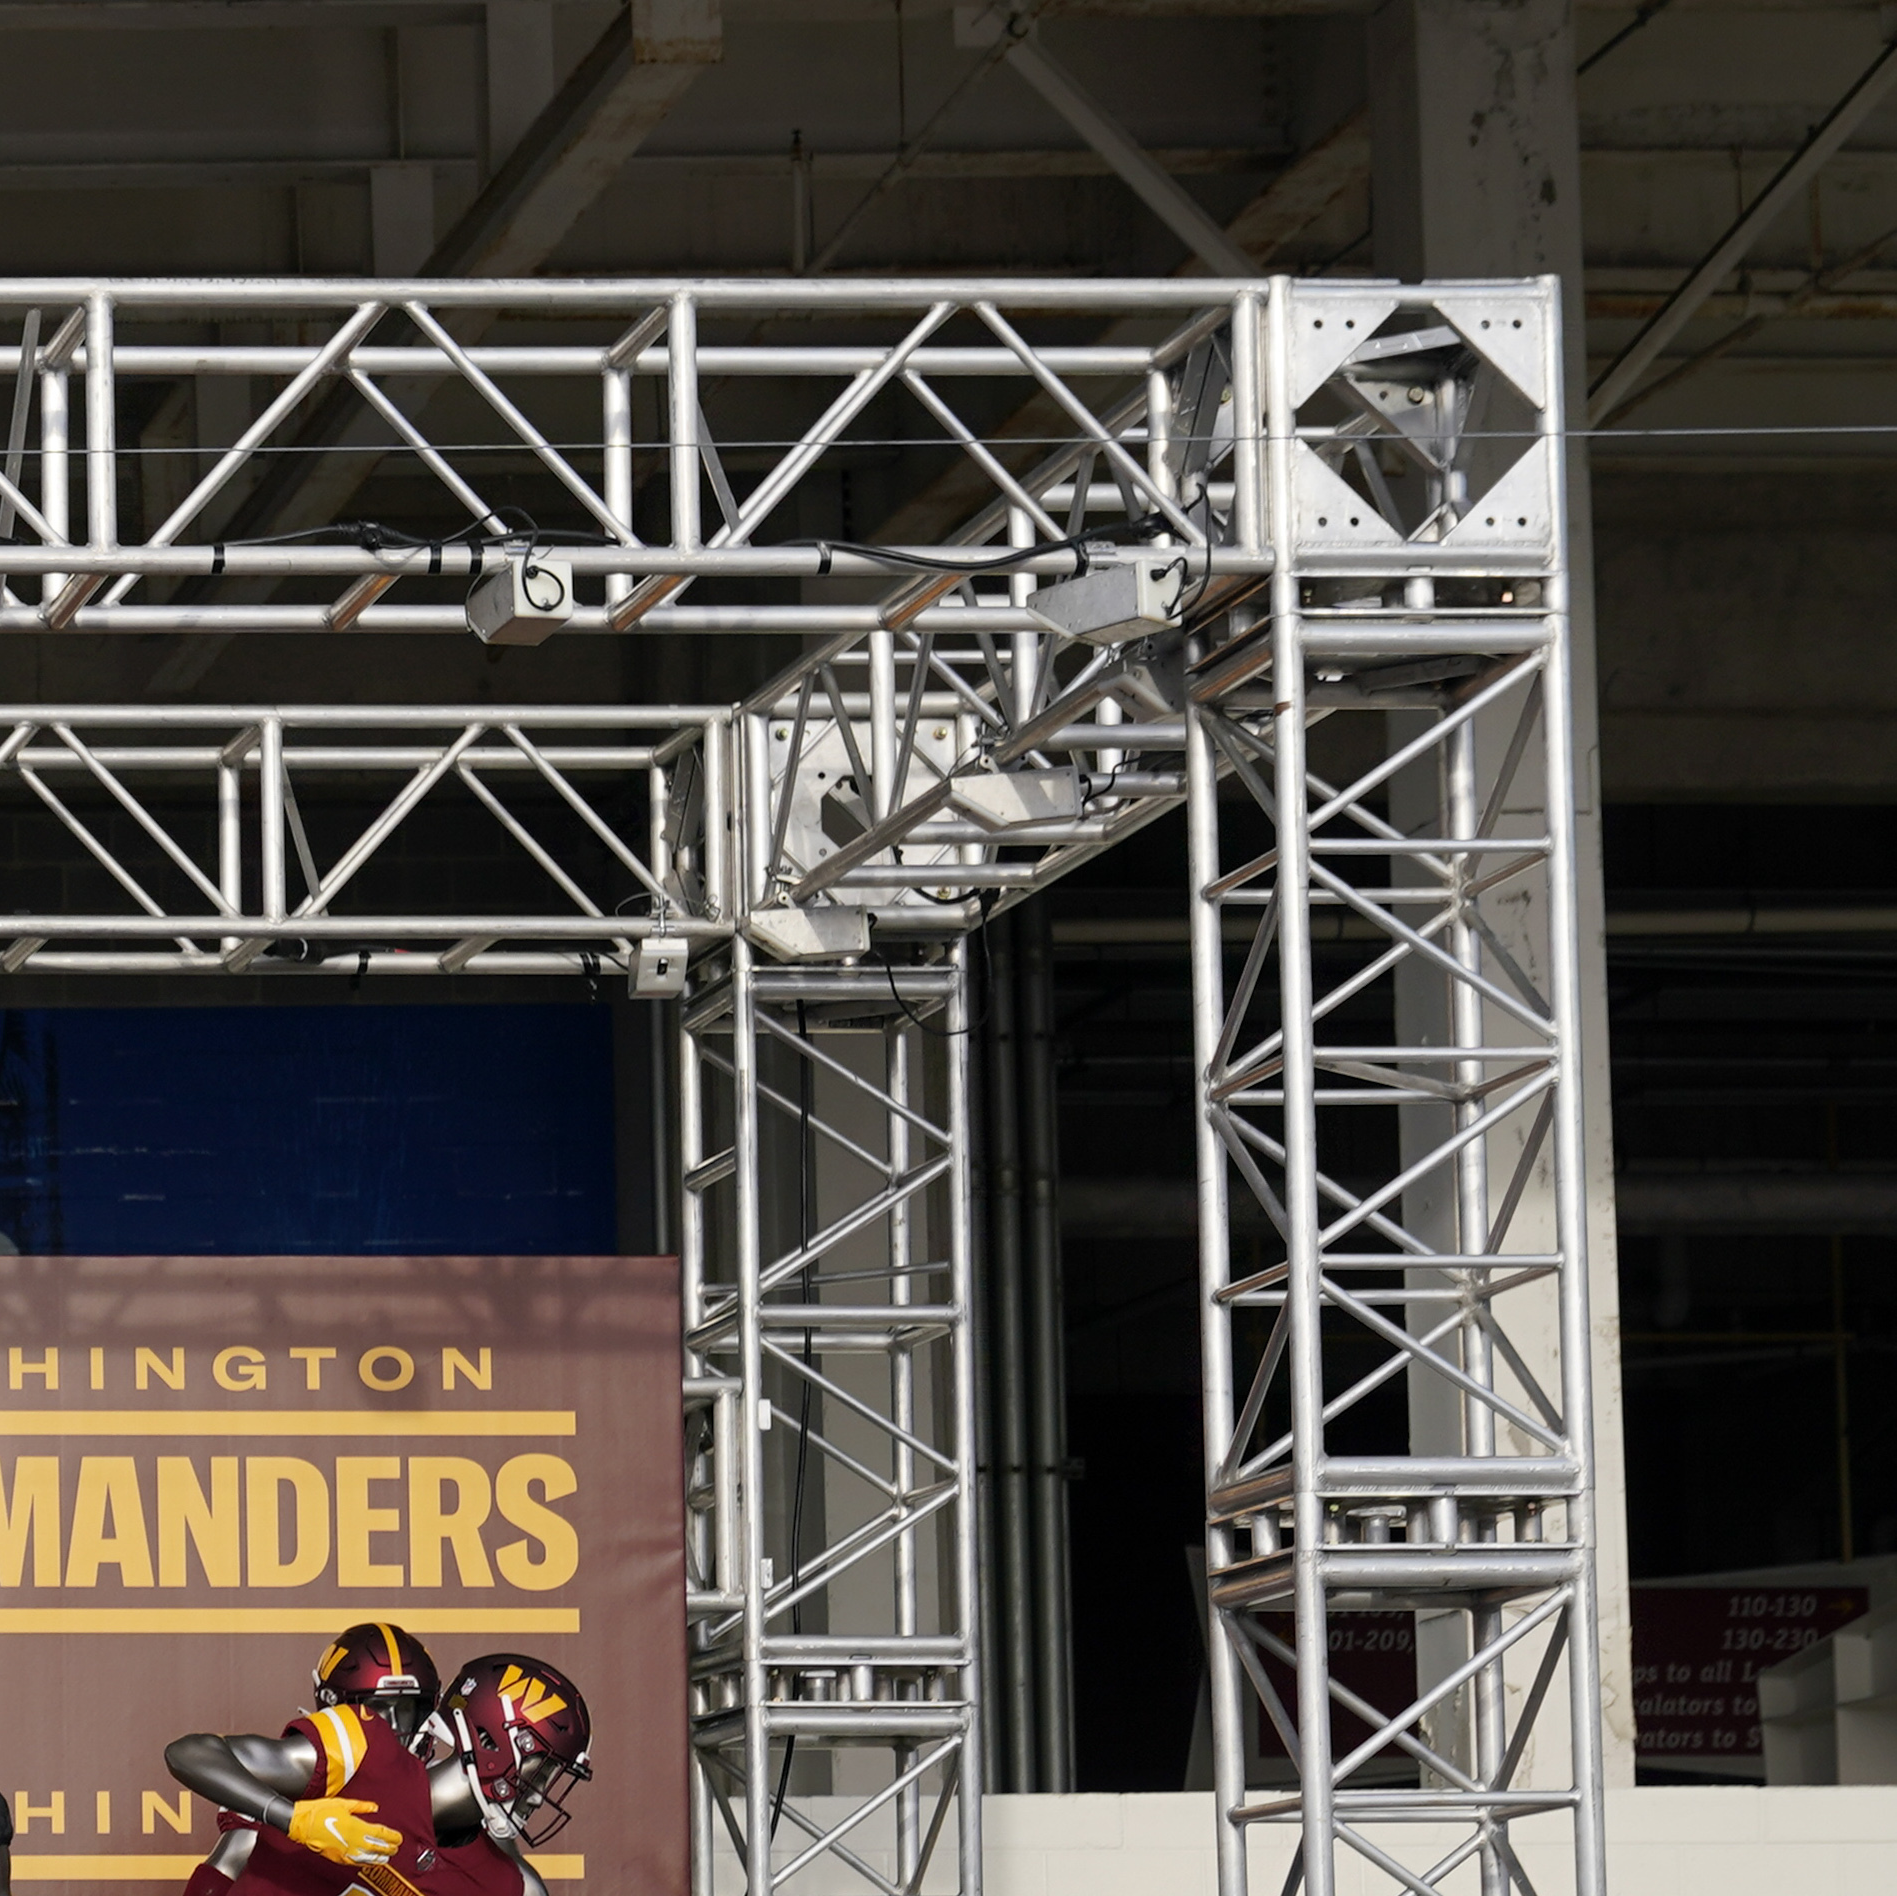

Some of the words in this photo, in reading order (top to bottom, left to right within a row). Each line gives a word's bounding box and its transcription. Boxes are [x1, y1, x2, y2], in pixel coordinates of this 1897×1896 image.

[1728, 1596, 1817, 1618] 110-130
[1329, 1629, 1414, 1654] 01-209,
[1721, 1628, 1819, 1651] 130-230
[1634, 1664, 1657, 1688] ps
[1667, 1662, 1691, 1683] to
[1700, 1660, 1732, 1683] all
[1742, 1660, 1762, 1683] L
[1635, 1694, 1722, 1716] alators
[1733, 1697, 1758, 1716] to
[1713, 1728, 1737, 1748] to
[1748, 1727, 1763, 1748] S
